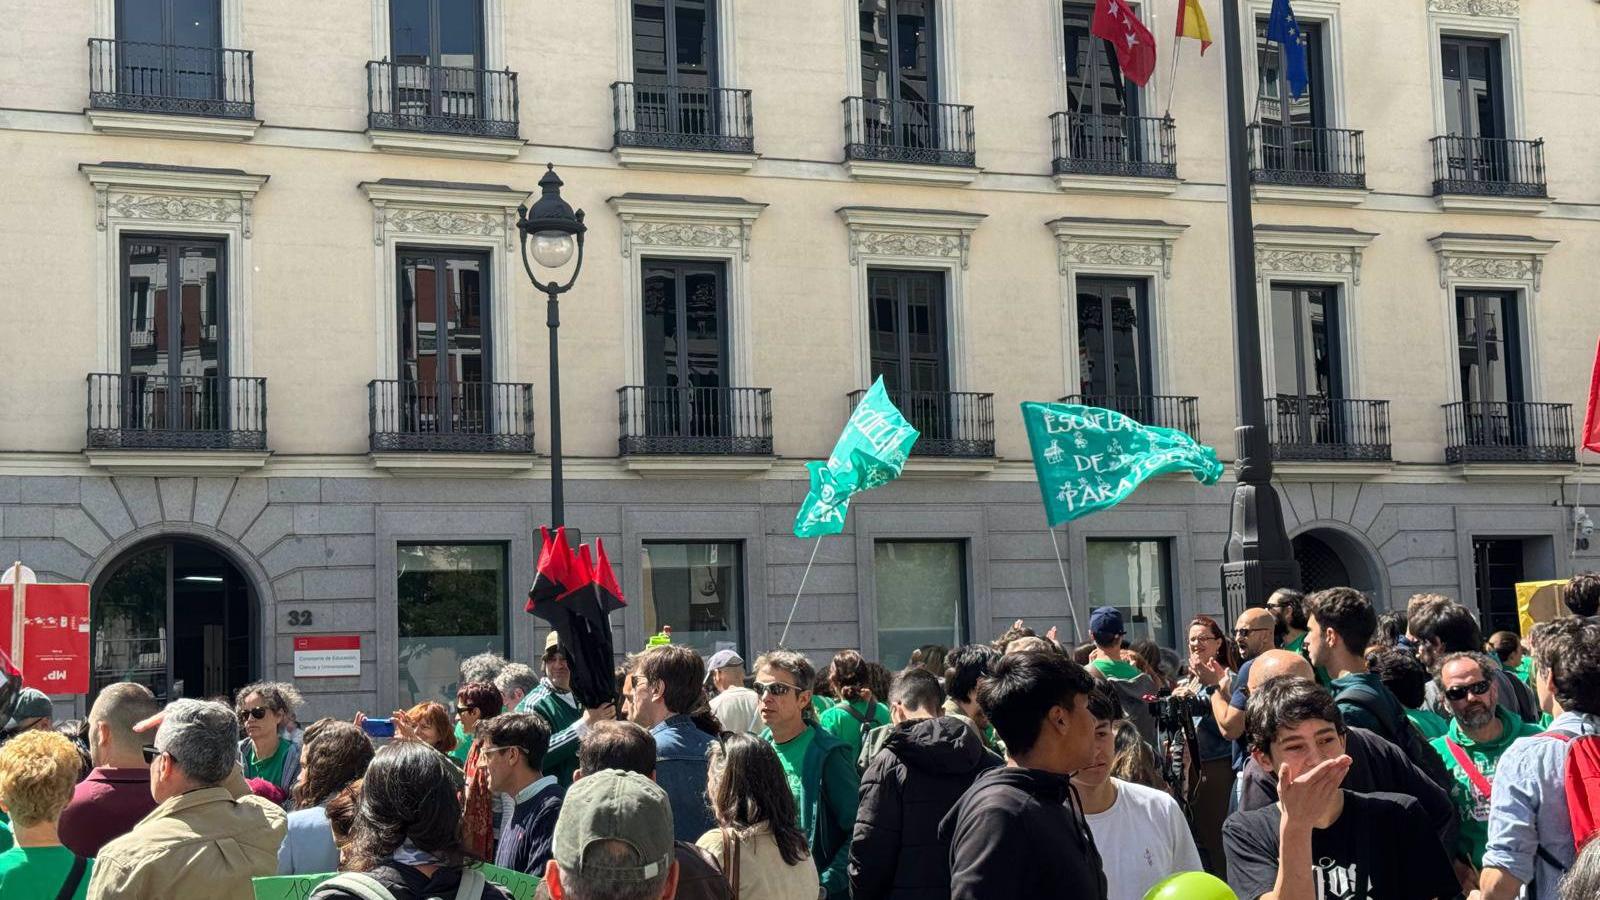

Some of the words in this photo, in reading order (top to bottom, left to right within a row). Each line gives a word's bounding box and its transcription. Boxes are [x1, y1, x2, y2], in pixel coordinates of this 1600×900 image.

[1074, 453, 1105, 474] DE
[1063, 478, 1134, 511] PARA
[288, 610, 312, 626] 32
